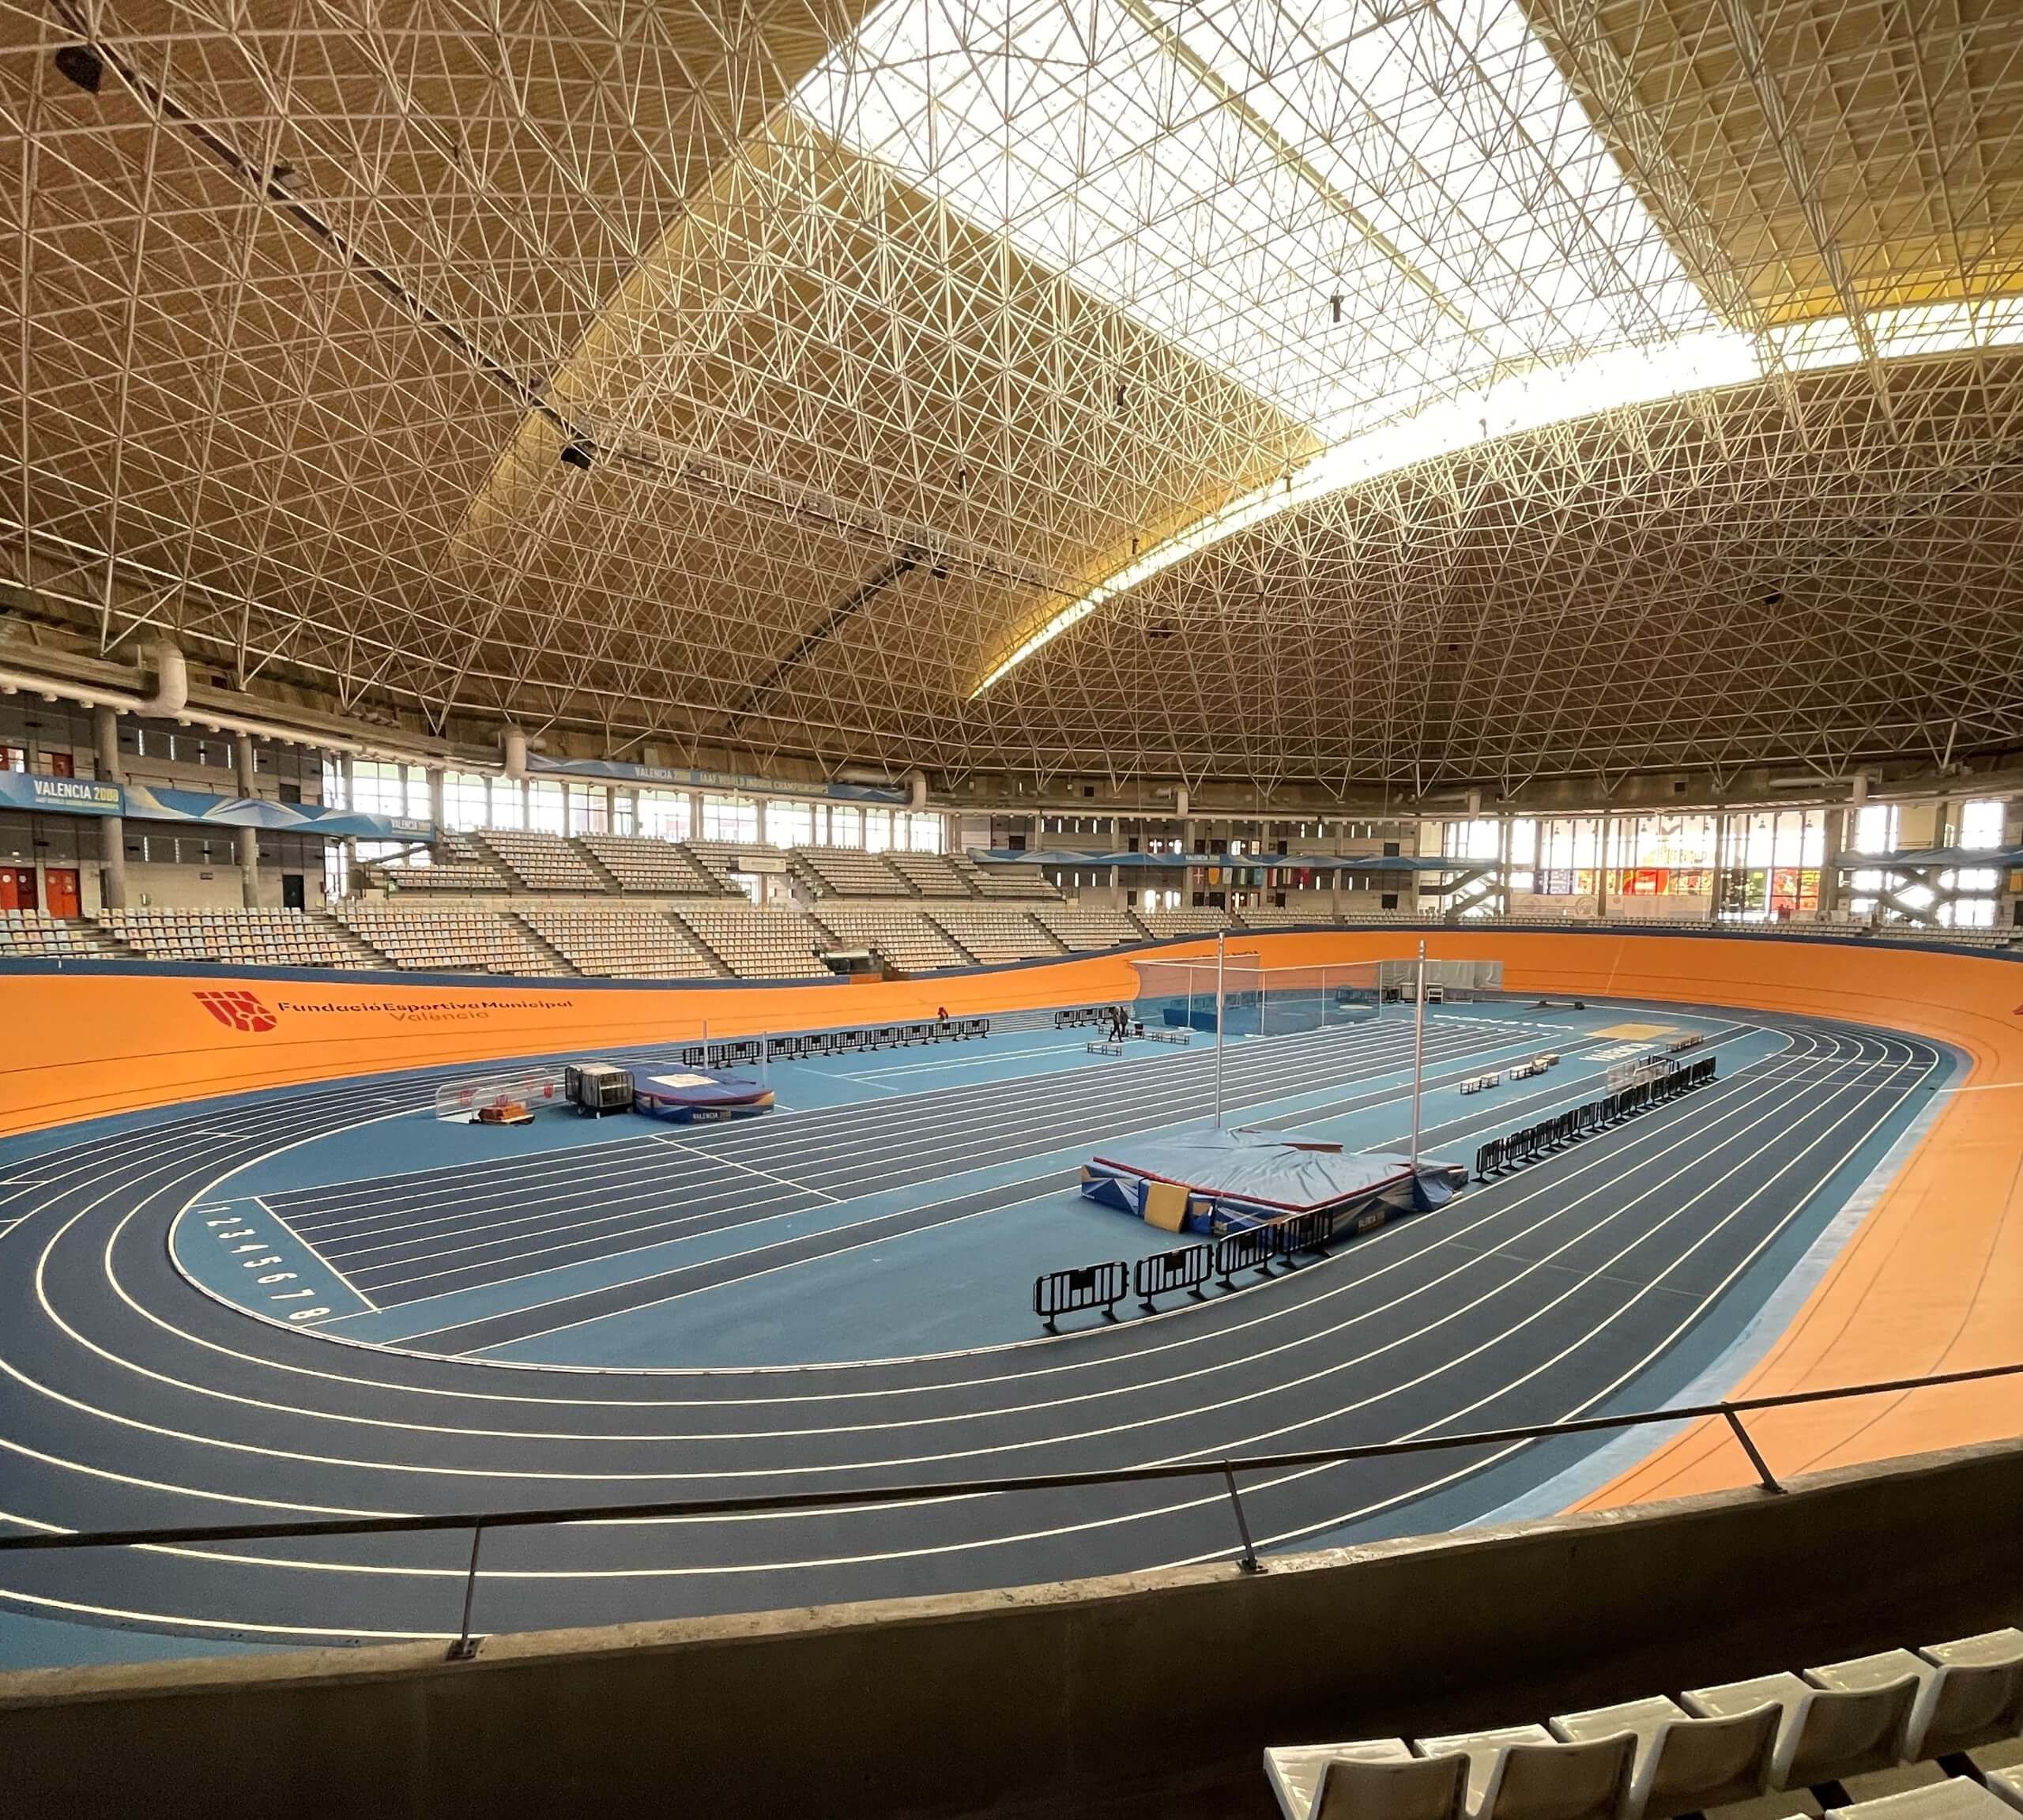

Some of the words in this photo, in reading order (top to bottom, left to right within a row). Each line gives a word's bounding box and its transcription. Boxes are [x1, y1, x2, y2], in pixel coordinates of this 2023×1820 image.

[34, 780, 92, 800] VALENCIA
[278, 1002, 381, 1012] Fundació
[383, 1002, 479, 1012] Esportiva
[481, 1000, 573, 1009] Municipal
[205, 1217, 242, 1227] 2
[218, 1229, 256, 1239] 3
[231, 1245, 269, 1253] 4
[243, 1256, 283, 1268] 5
[257, 1272, 298, 1284] 6
[270, 1288, 315, 1299] 7
[288, 1307, 330, 1320] 8
